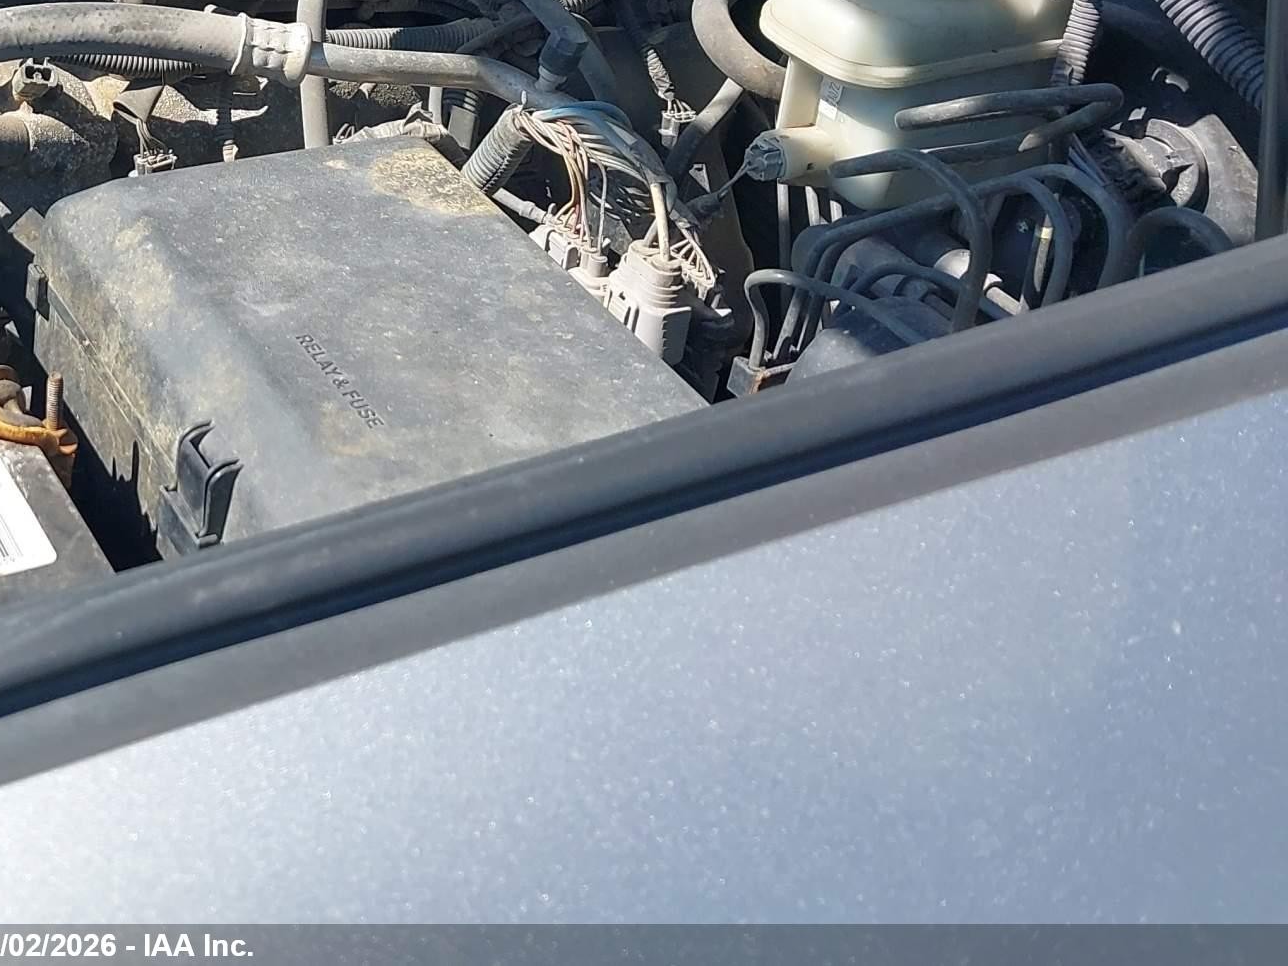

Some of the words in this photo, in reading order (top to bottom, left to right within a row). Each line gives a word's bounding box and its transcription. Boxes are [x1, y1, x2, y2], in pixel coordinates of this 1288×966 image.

[295, 334, 344, 376] RELAY
[332, 378, 350, 390] &
[342, 390, 384, 429] FUSE
